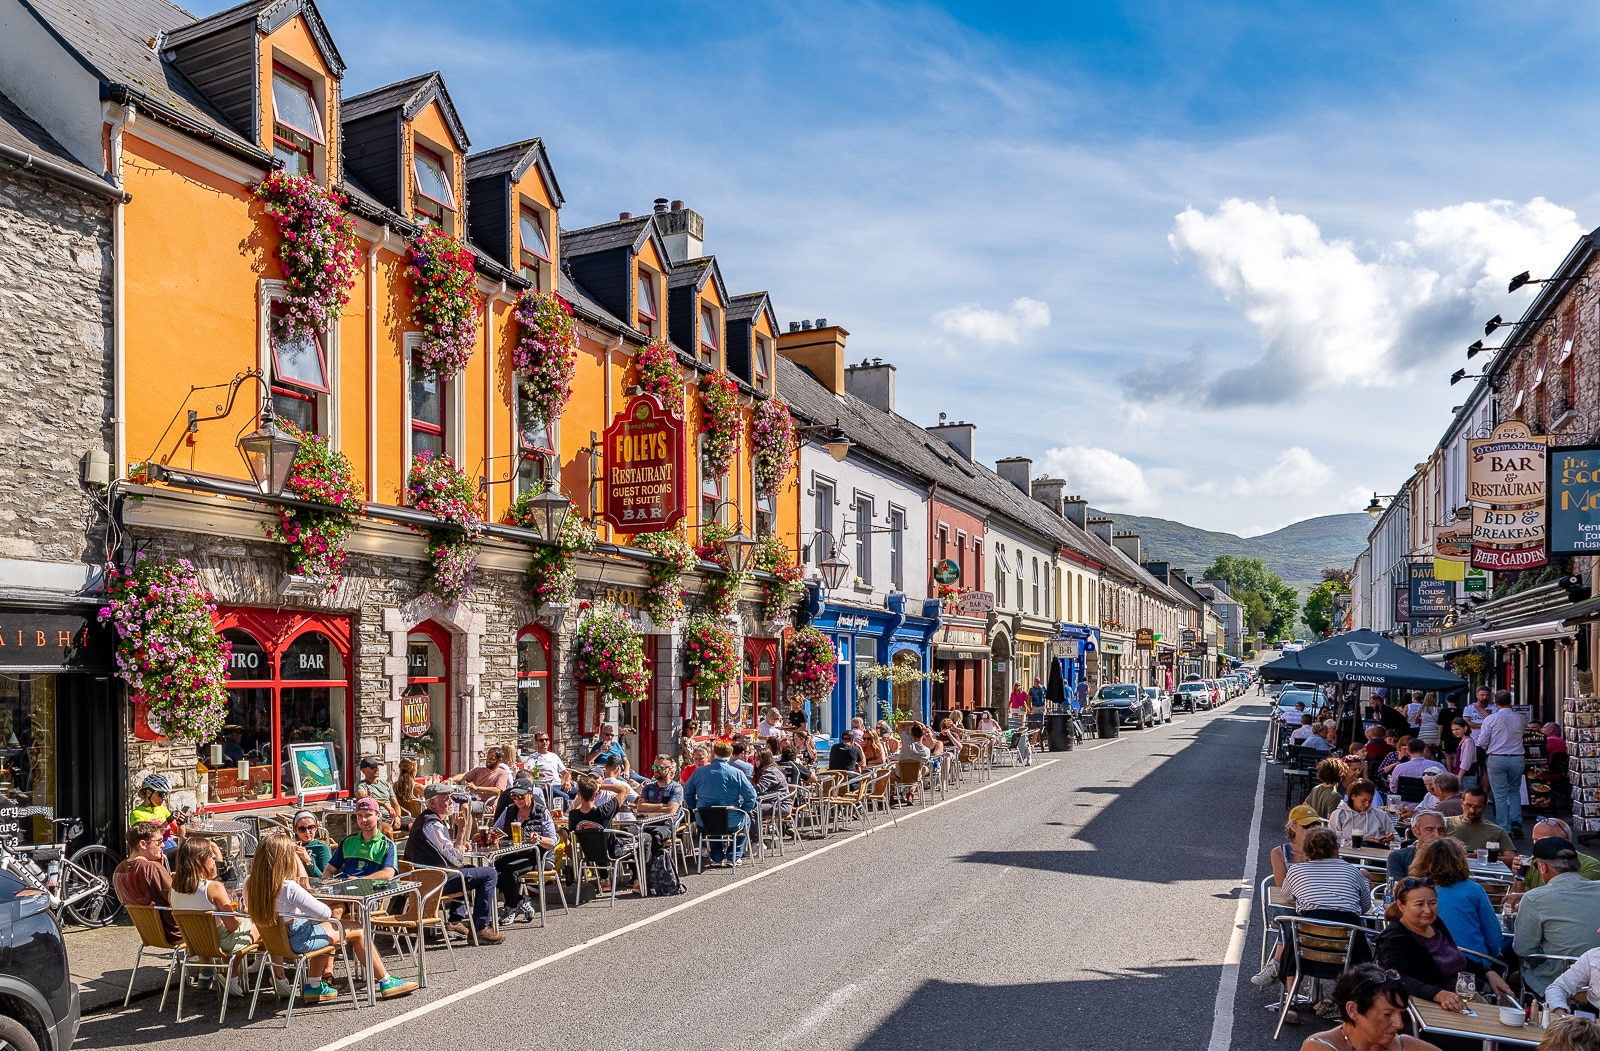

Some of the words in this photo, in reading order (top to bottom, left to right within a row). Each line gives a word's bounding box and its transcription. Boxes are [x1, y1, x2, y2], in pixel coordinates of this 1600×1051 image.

[616, 430, 667, 463] FOLEYS
[1490, 456, 1536, 472] BAR
[612, 463, 673, 485] RESTAURANT
[1504, 473, 1518, 482] &
[612, 486, 640, 498] GUEST
[641, 483, 672, 495] ROOMS
[623, 497, 634, 506] EN
[635, 495, 661, 505] SUITE
[622, 507, 663, 520] BAR
[1483, 511, 1516, 525] BED
[1522, 510, 1540, 525] &
[1473, 524, 1545, 540] BREAKFAST
[1474, 548, 1502, 566] BEER
[1501, 548, 1546, 565] GARDEN
[1420, 580, 1446, 589] guest
[1412, 627, 1442, 635] garden
[230, 653, 259, 669] TRO
[299, 654, 325, 669] BAR
[1326, 658, 1398, 670] GUINNESS
[1345, 673, 1386, 683] GUINNESS
[404, 702, 428, 725] MUSIC
[404, 724, 427, 735] Tonight
[0, 806, 18, 817] ery
